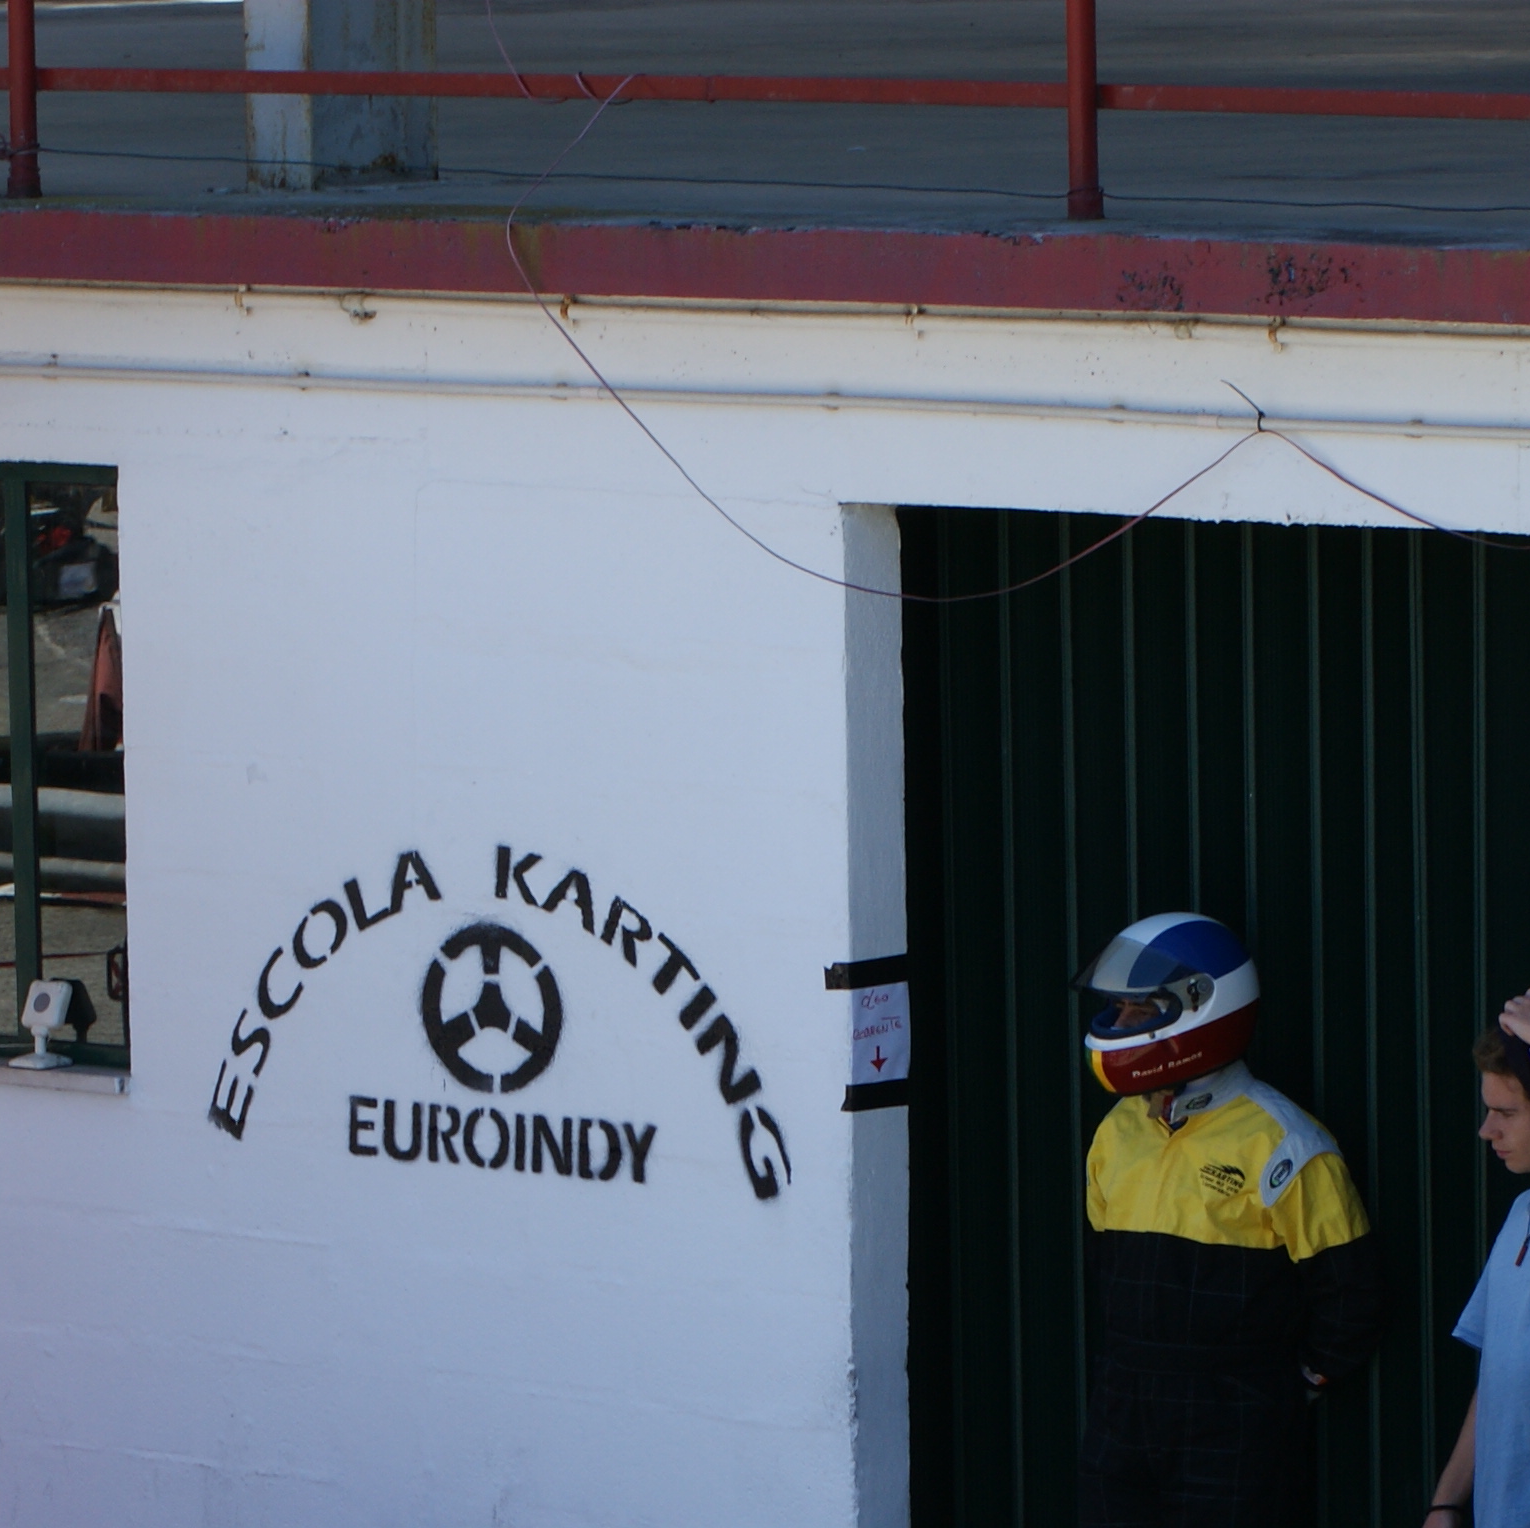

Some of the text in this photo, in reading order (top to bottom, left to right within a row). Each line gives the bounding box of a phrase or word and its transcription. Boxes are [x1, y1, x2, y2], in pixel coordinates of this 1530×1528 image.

[208, 844, 792, 1201] ESCOLA KARTING
[1131, 1050, 1204, 1079] David Ramos
[348, 1095, 657, 1184] EUROINDY
